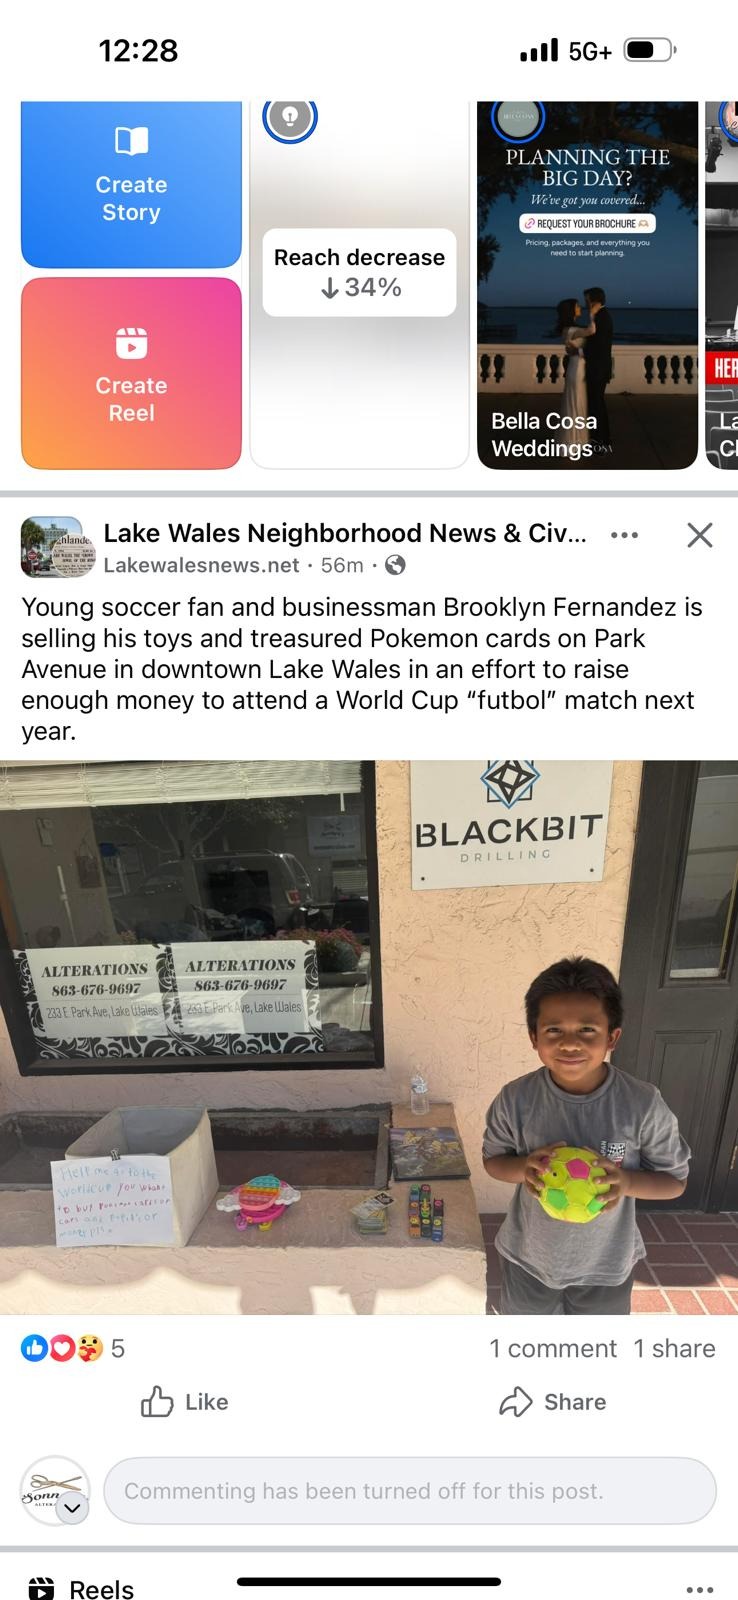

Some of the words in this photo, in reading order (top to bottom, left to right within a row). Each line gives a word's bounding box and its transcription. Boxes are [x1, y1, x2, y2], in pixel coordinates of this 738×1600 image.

[99, 39, 178, 62] 12:28
[570, 42, 612, 61] 5G+
[507, 150, 619, 164] PLANNING
[626, 149, 669, 164] THE
[96, 176, 167, 193] Create
[544, 171, 577, 185] BIG
[584, 171, 632, 185] DAY?
[562, 197, 578, 209] got
[579, 197, 598, 209] you
[103, 204, 160, 224] Story
[538, 219, 571, 230] REQUEST
[573, 219, 593, 228] YOUR
[595, 219, 636, 228] BROCHURE
[525, 239, 551, 248] Pricing,
[551, 239, 585, 248] packages,
[600, 239, 636, 248] everything
[637, 240, 650, 248] you
[275, 248, 339, 266] Reach
[347, 248, 445, 266] decrease
[550, 249, 568, 257] need
[594, 249, 624, 258] planning.
[345, 277, 401, 297] 34%
[96, 376, 168, 395] Create
[109, 403, 154, 422] Reel
[493, 412, 539, 429] Bella
[547, 413, 596, 429] Cosa
[492, 439, 592, 460] Weddings
[719, 439, 738, 457] C
[105, 522, 160, 543] Lake
[168, 523, 240, 543] Wales
[249, 522, 421, 547] Neighborhood
[430, 523, 496, 543] News
[504, 523, 521, 543] &
[529, 522, 586, 543] Civ...
[105, 557, 299, 573] Lakewalesnews.net
[322, 557, 363, 573] 56m
[22, 597, 93, 621] Young
[102, 602, 181, 616] soccer
[188, 596, 223, 616] fan
[232, 597, 274, 616] and
[283, 596, 435, 616] businessman
[445, 597, 545, 621] Brooklyn
[555, 597, 676, 616] Fernandez
[686, 596, 702, 616] is
[22, 628, 95, 652] selling
[104, 628, 136, 648] his
[144, 630, 192, 652] toys
[201, 628, 242, 648] and
[250, 628, 361, 648] treasured
[372, 628, 477, 648] Pokemon
[486, 628, 550, 648] cards
[558, 633, 585, 648] on
[596, 628, 645, 648] Park
[22, 660, 106, 679] Avenue
[115, 659, 133, 678] in
[142, 659, 261, 678] downtown
[270, 659, 323, 679] Lake
[332, 659, 400, 679] Wales
[409, 659, 428, 678] in
[436, 664, 462, 679] an
[472, 659, 535, 678] effort
[543, 661, 566, 678] to
[575, 659, 628, 678] raise
[22, 690, 107, 714] enough
[117, 695, 194, 714] money
[202, 692, 224, 709] to
[233, 690, 306, 709] attend
[316, 695, 327, 709] a
[336, 690, 402, 709] World
[412, 690, 458, 714] Cup
[468, 690, 555, 709] “futbol”
[566, 690, 636, 709] match
[646, 692, 694, 709] next
[22, 726, 75, 745] year.
[416, 814, 604, 848] BLACKBIT
[460, 849, 551, 863] DRILLING
[42, 963, 148, 978] ALTERATIONS
[185, 958, 296, 973] ALTERATIONS
[51, 983, 141, 997] 863-676-9697
[194, 979, 288, 992] 863-676-9697
[46, 1007, 60, 1019] 233
[62, 1006, 68, 1018] E
[71, 1005, 91, 1018] Park
[92, 1005, 111, 1019] Ave,
[111, 1004, 130, 1017] Lake
[131, 1003, 159, 1017] Wales
[213, 1001, 234, 1014] Park
[236, 1000, 254, 1015] Ave,
[254, 1001, 274, 1013] Lake
[275, 1000, 302, 1013] Wales
[112, 1339, 124, 1358] 5
[490, 1339, 498, 1358] 1
[508, 1340, 617, 1358] comment
[635, 1339, 642, 1358] 1
[653, 1338, 715, 1358] share
[186, 1392, 228, 1410] Like
[545, 1393, 606, 1410] Share
[21, 1492, 60, 1505] Sonn
[125, 1482, 255, 1503] Commenting
[264, 1482, 298, 1499] has
[306, 1482, 356, 1499] been
[363, 1482, 430, 1499] turned
[439, 1482, 466, 1499] off
[473, 1482, 502, 1499] for
[508, 1482, 544, 1499] this
[553, 1484, 603, 1503] post.
[71, 1580, 134, 1600] Reels
